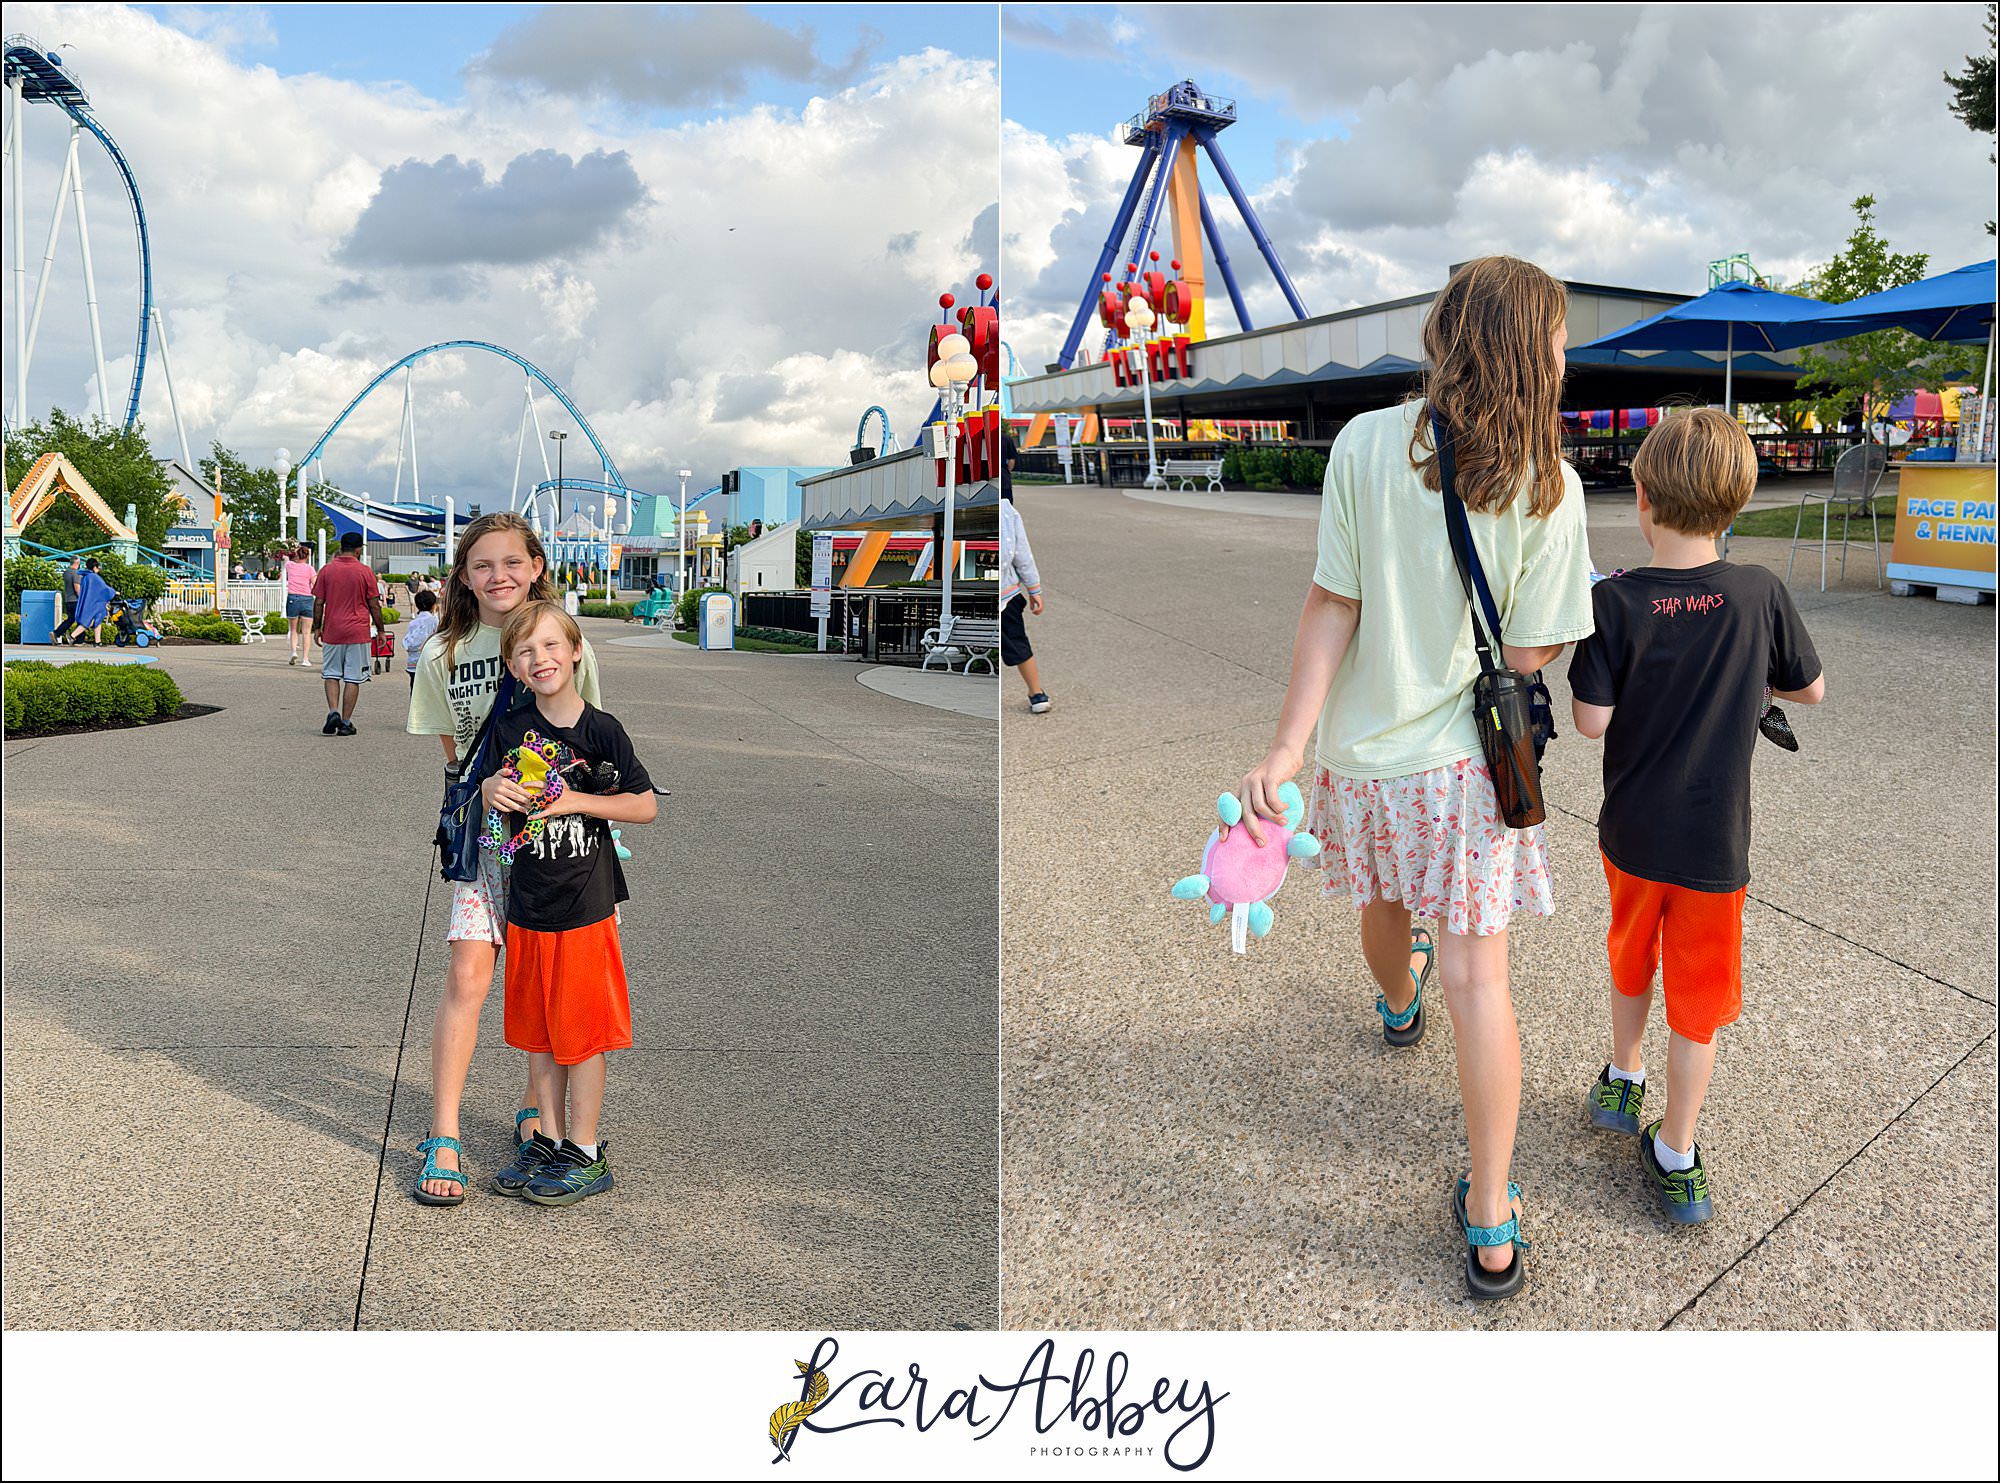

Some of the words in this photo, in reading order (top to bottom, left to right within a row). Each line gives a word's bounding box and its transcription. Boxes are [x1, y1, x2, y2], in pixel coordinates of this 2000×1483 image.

[1907, 497, 1957, 518] FACE
[1915, 521, 1932, 539] &
[1937, 522, 1996, 545] HENN
[1651, 597, 1682, 618] STAR
[1685, 593, 1724, 615] WARS
[448, 683, 482, 700] NIGHT
